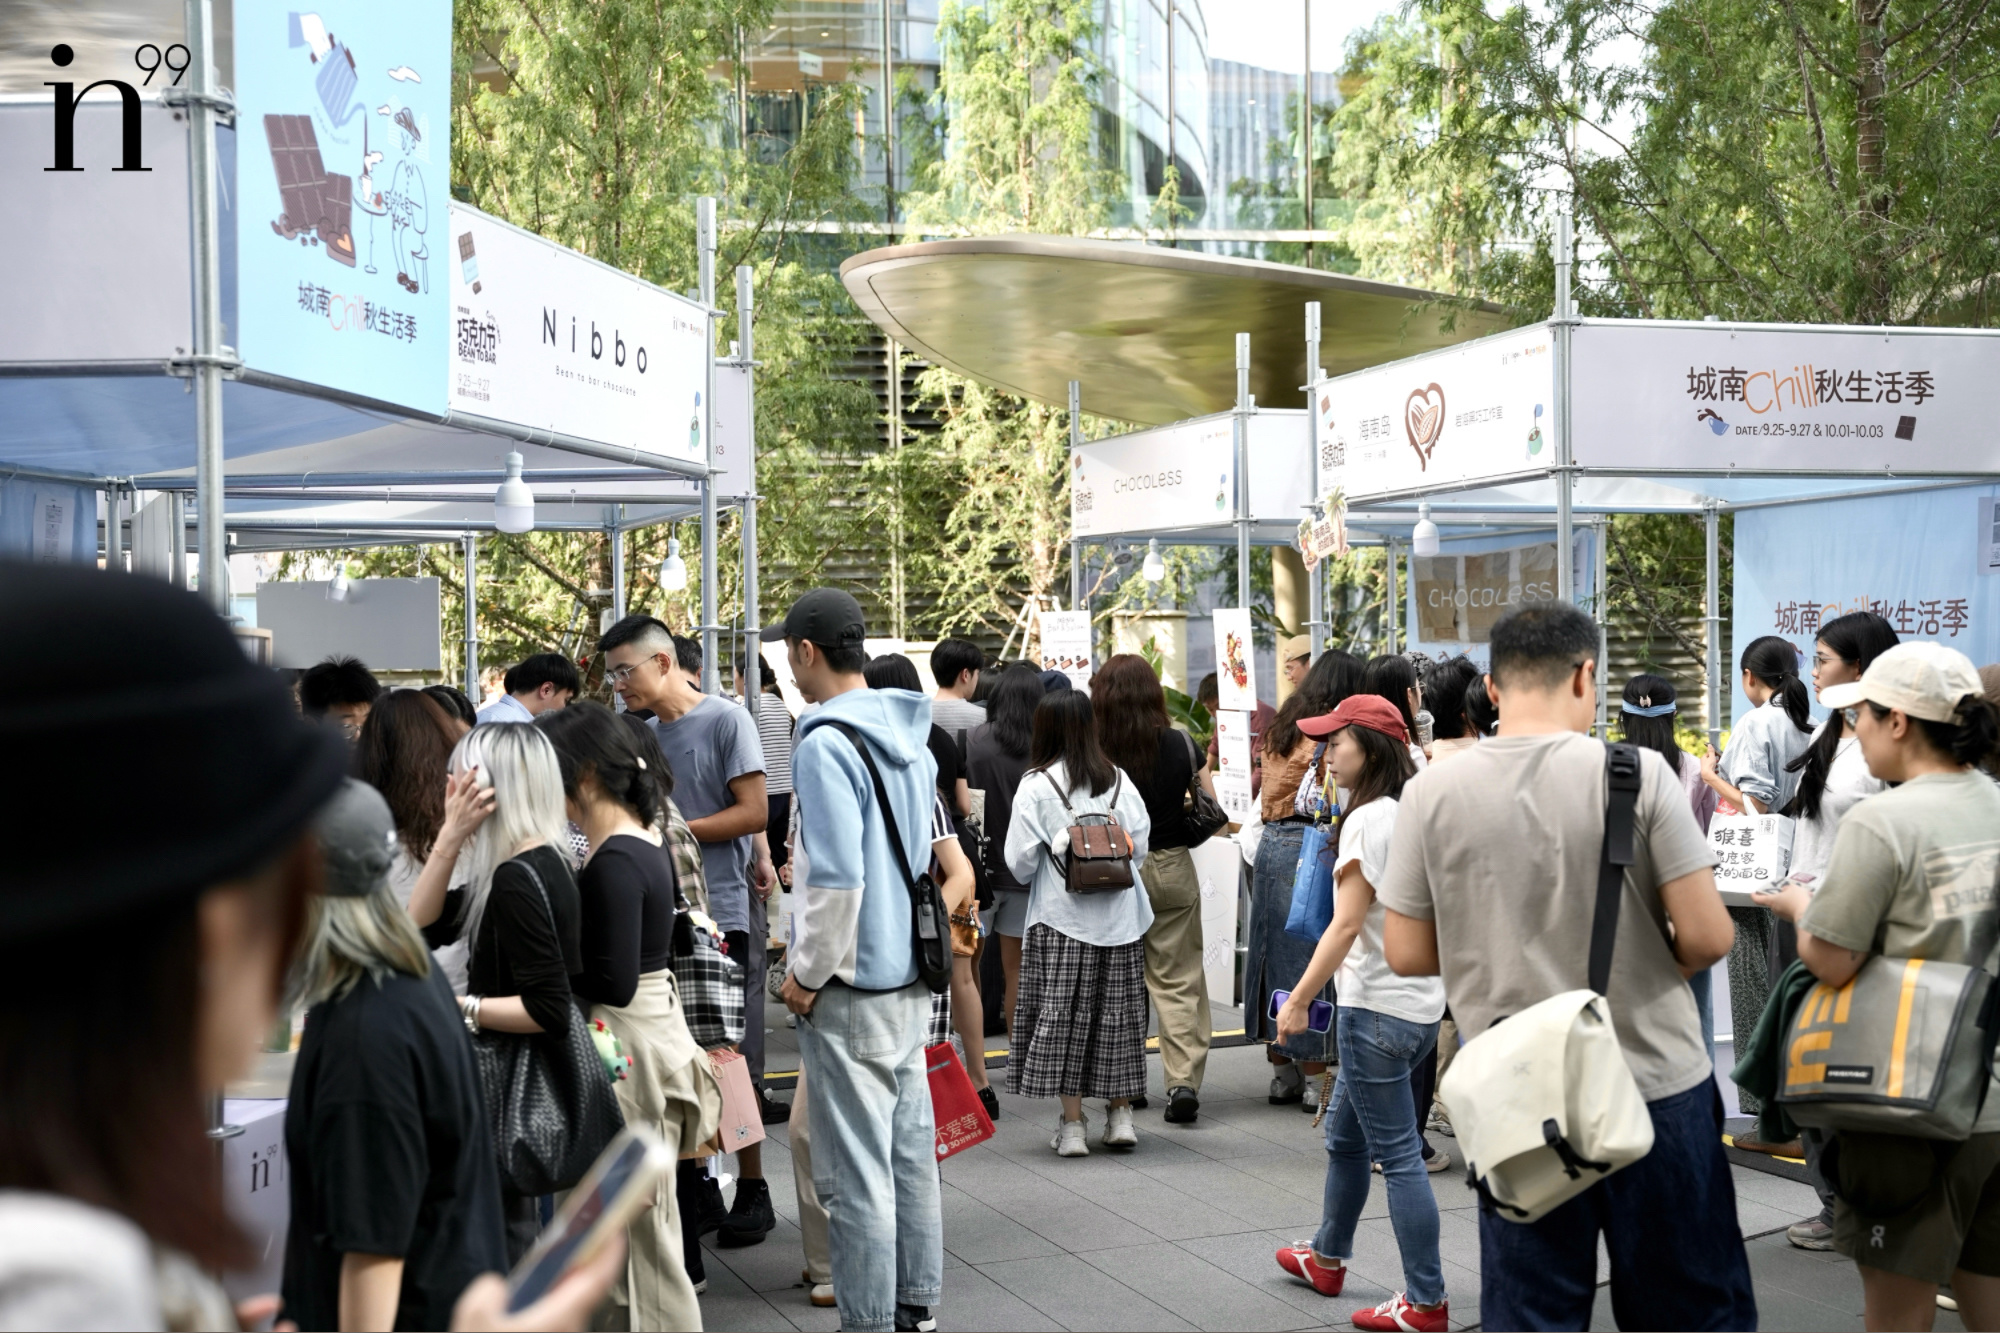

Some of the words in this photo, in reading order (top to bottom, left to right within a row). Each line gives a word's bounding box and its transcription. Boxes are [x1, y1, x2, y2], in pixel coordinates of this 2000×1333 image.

[457, 317, 496, 351] 巧克力节
[543, 305, 648, 374] Nibbo
[458, 341, 476, 359] BEAN
[476, 348, 485, 361] TO
[485, 350, 497, 365] BAR
[1686, 364, 1936, 414] 城南Chill秋生活季
[1813, 424, 1822, 437] &
[1825, 424, 1884, 438] 10.01-10.03
[935, 1112, 978, 1143] 不爱等
